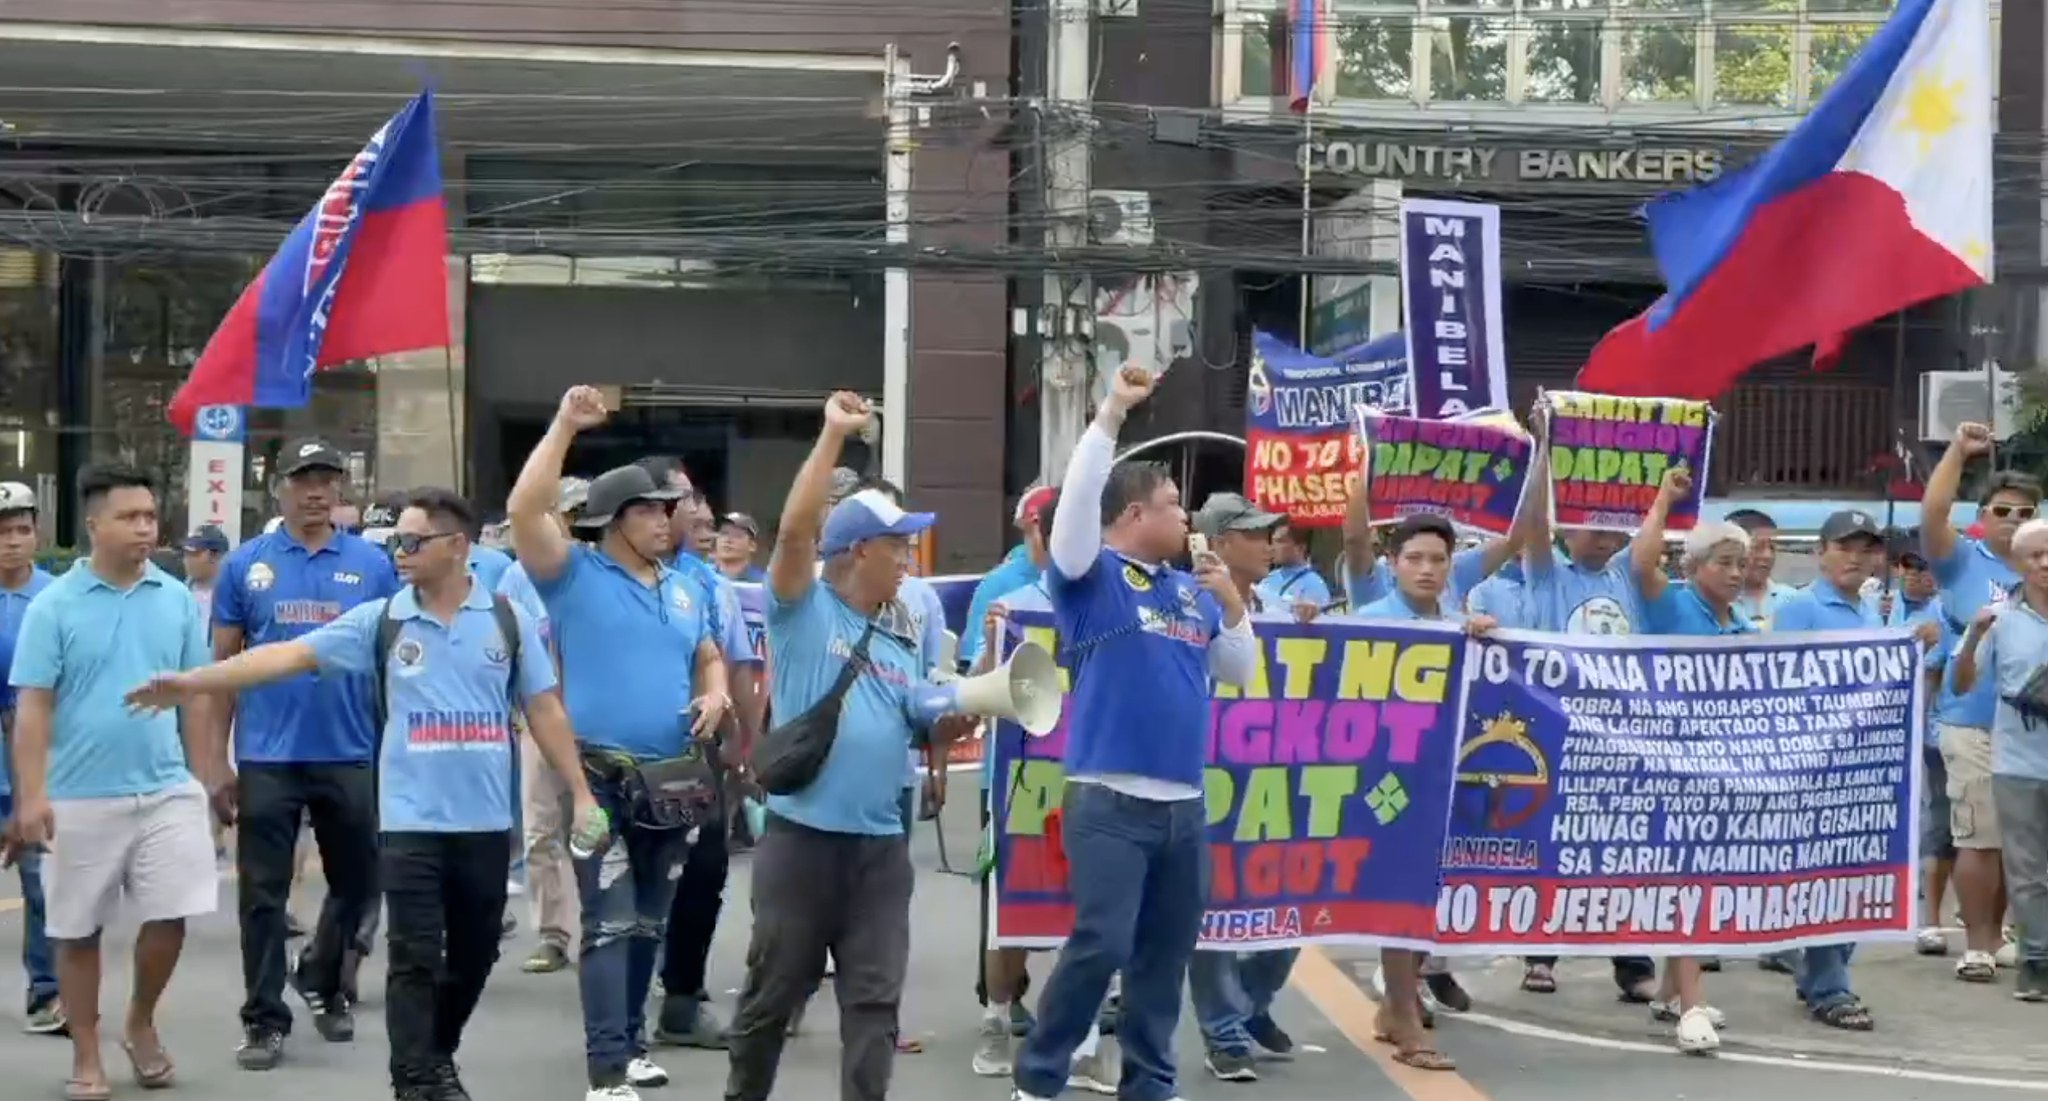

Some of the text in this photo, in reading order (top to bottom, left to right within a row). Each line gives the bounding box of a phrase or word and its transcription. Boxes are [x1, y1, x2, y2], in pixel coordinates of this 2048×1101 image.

[1296, 141, 1723, 182] COUNTRY BANKERS
[1425, 217, 1469, 419] MANIBELA
[1254, 440, 1292, 471] NO
[1298, 440, 1341, 468] TO
[1374, 442, 1491, 483] DAPAT
[1552, 446, 1668, 487] DAPAT
[206, 459, 226, 525] EXI
[1337, 640, 1451, 703] NG
[1523, 648, 1567, 688] TO
[1572, 652, 1649, 691] NAIA
[1652, 645, 1910, 692] PRIVATIZATION!
[1560, 689, 1910, 718] SOBRA NA ANG KORAPSYON! TAUMBAYAN
[1568, 715, 1605, 734] ANG
[1607, 716, 1674, 736] LAGING
[1678, 716, 1770, 736] APEKTADO
[1775, 715, 1800, 733] SA
[1803, 712, 1852, 732] TAAS
[1559, 754, 1639, 772] AIRPORT
[1643, 756, 1667, 773] NA
[1742, 756, 1766, 772] NA
[1769, 751, 1829, 770] NATING
[1684, 740, 1726, 757] TAYO
[1728, 737, 1777, 756] NANG
[1778, 733, 1835, 753] DOBLE
[1557, 776, 1629, 795] ILILIPAT
[1632, 778, 1680, 794] LANG
[1683, 778, 1720, 794] ANG
[1724, 773, 1824, 794] PAMAMAHALA
[1609, 795, 1657, 812] PERO
[1661, 796, 1704, 812] TAYO
[1708, 796, 1730, 812] PA
[1734, 796, 1763, 811] RIN
[1766, 793, 1799, 811] ANG
[1551, 803, 1897, 843] HUWAG NYO KAMING GISAHIN
[1558, 834, 1889, 875] SA SARILI NAMING MANTIKA!
[1488, 885, 1538, 934] TO
[1542, 884, 1702, 937] JEEPNEY
[1709, 873, 1896, 932] PHASEOUT!!!
